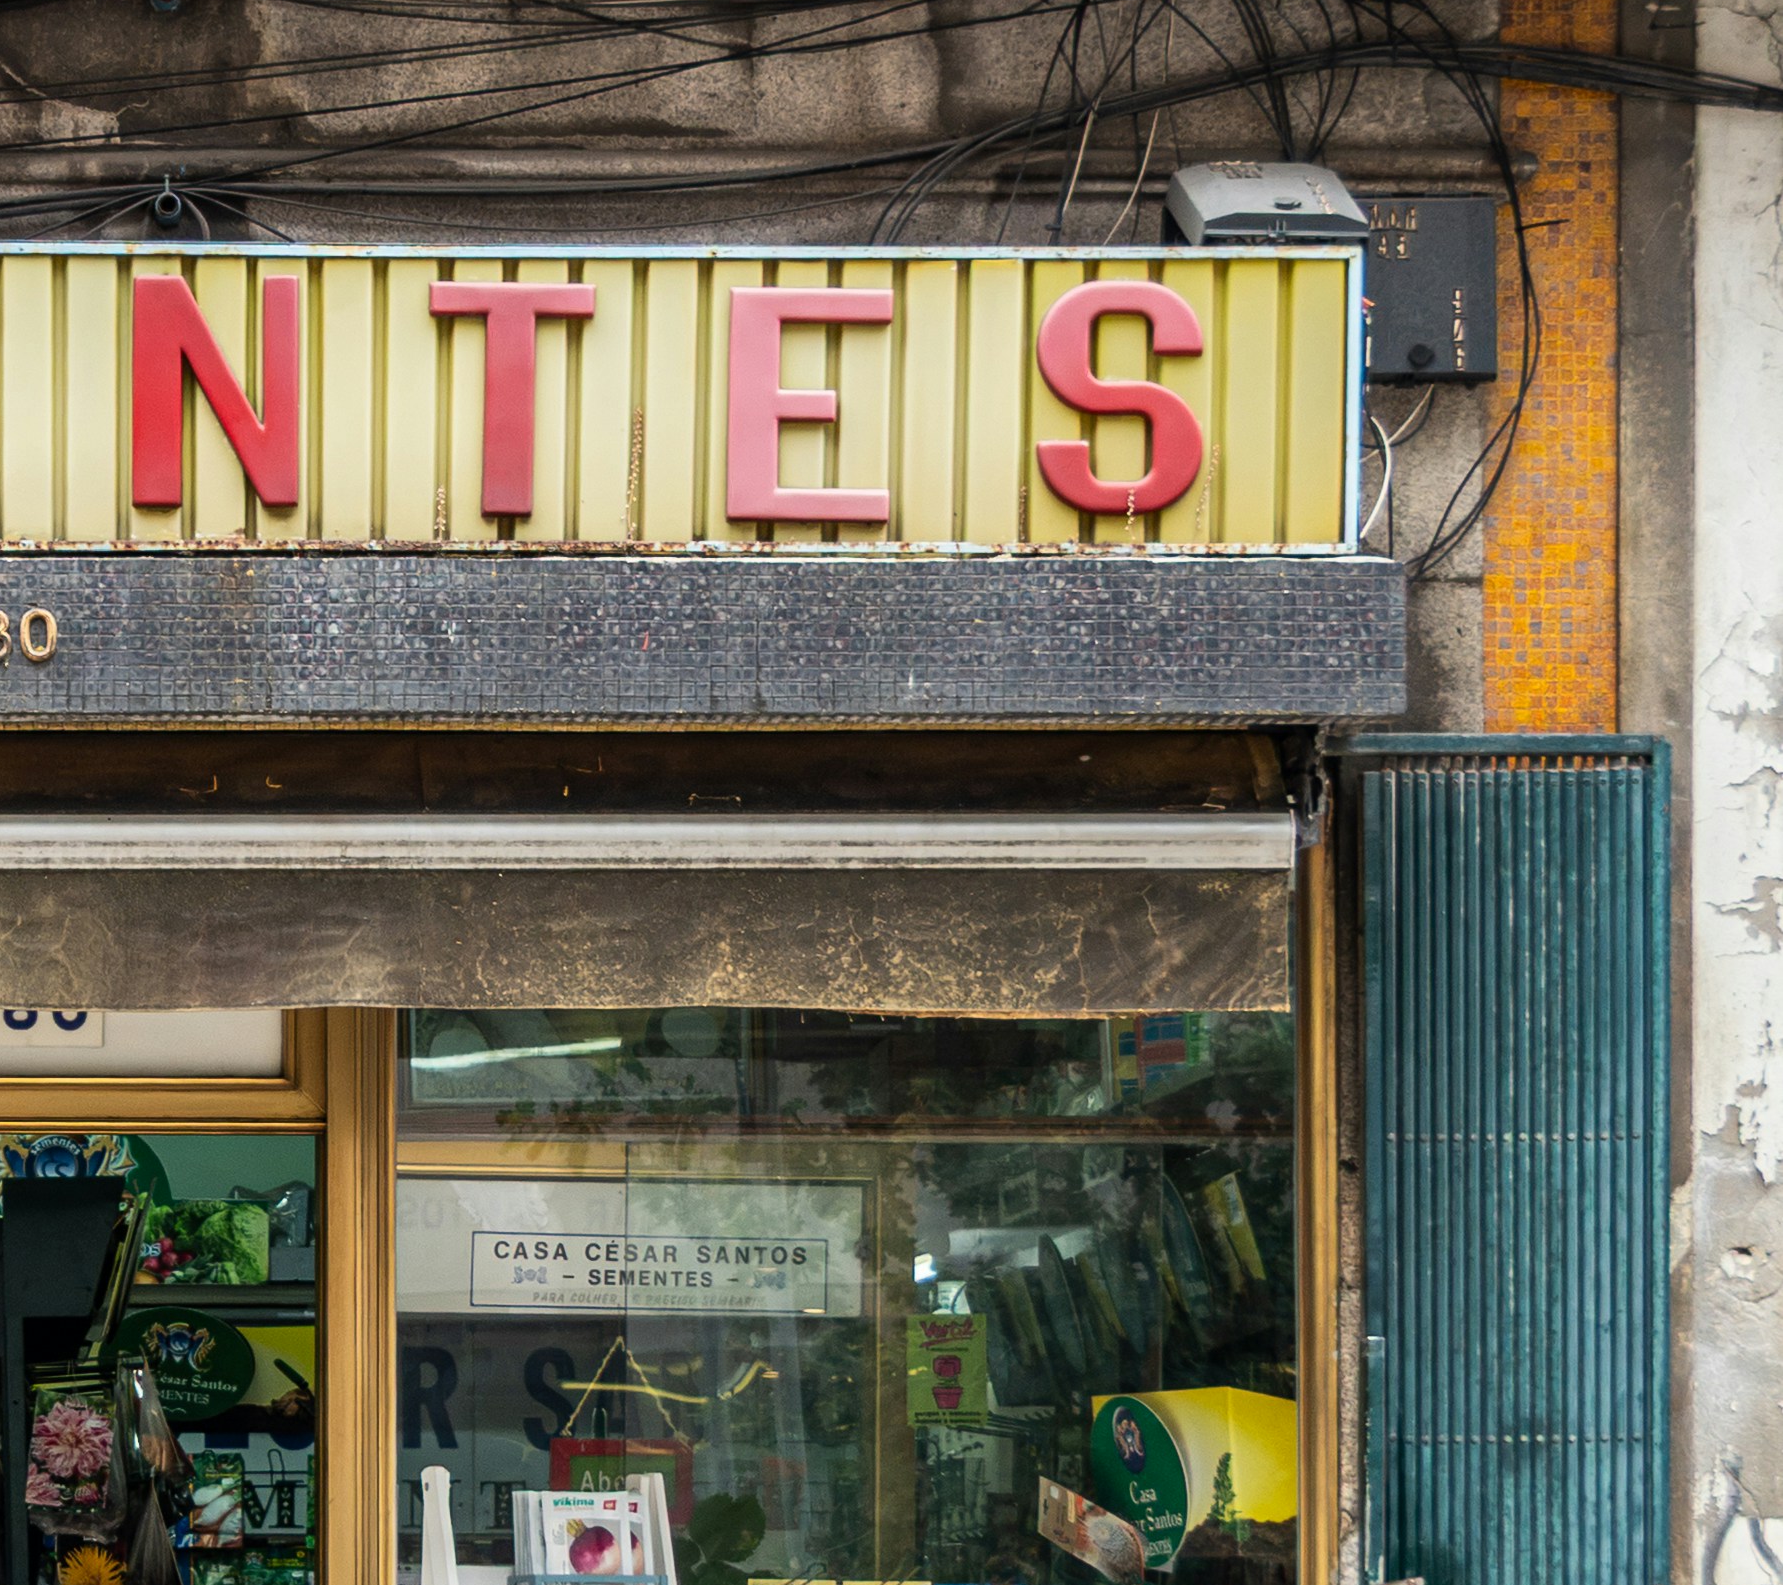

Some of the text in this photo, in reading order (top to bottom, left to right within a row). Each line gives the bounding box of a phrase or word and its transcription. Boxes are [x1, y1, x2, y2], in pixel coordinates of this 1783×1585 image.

[30, 1136, 81, 1156] sementes
[493, 1239, 808, 1265] CASA CÉSAR SANTOS
[587, 1268, 714, 1288] SEMENTES
[532, 1291, 567, 1304] PARA
[191, 1373, 238, 1393] Santos
[158, 1389, 211, 1406] MENTES
[552, 1496, 595, 1508] vikima
[1129, 1480, 1157, 1504] Casa
[1148, 1508, 1183, 1531] Santos
